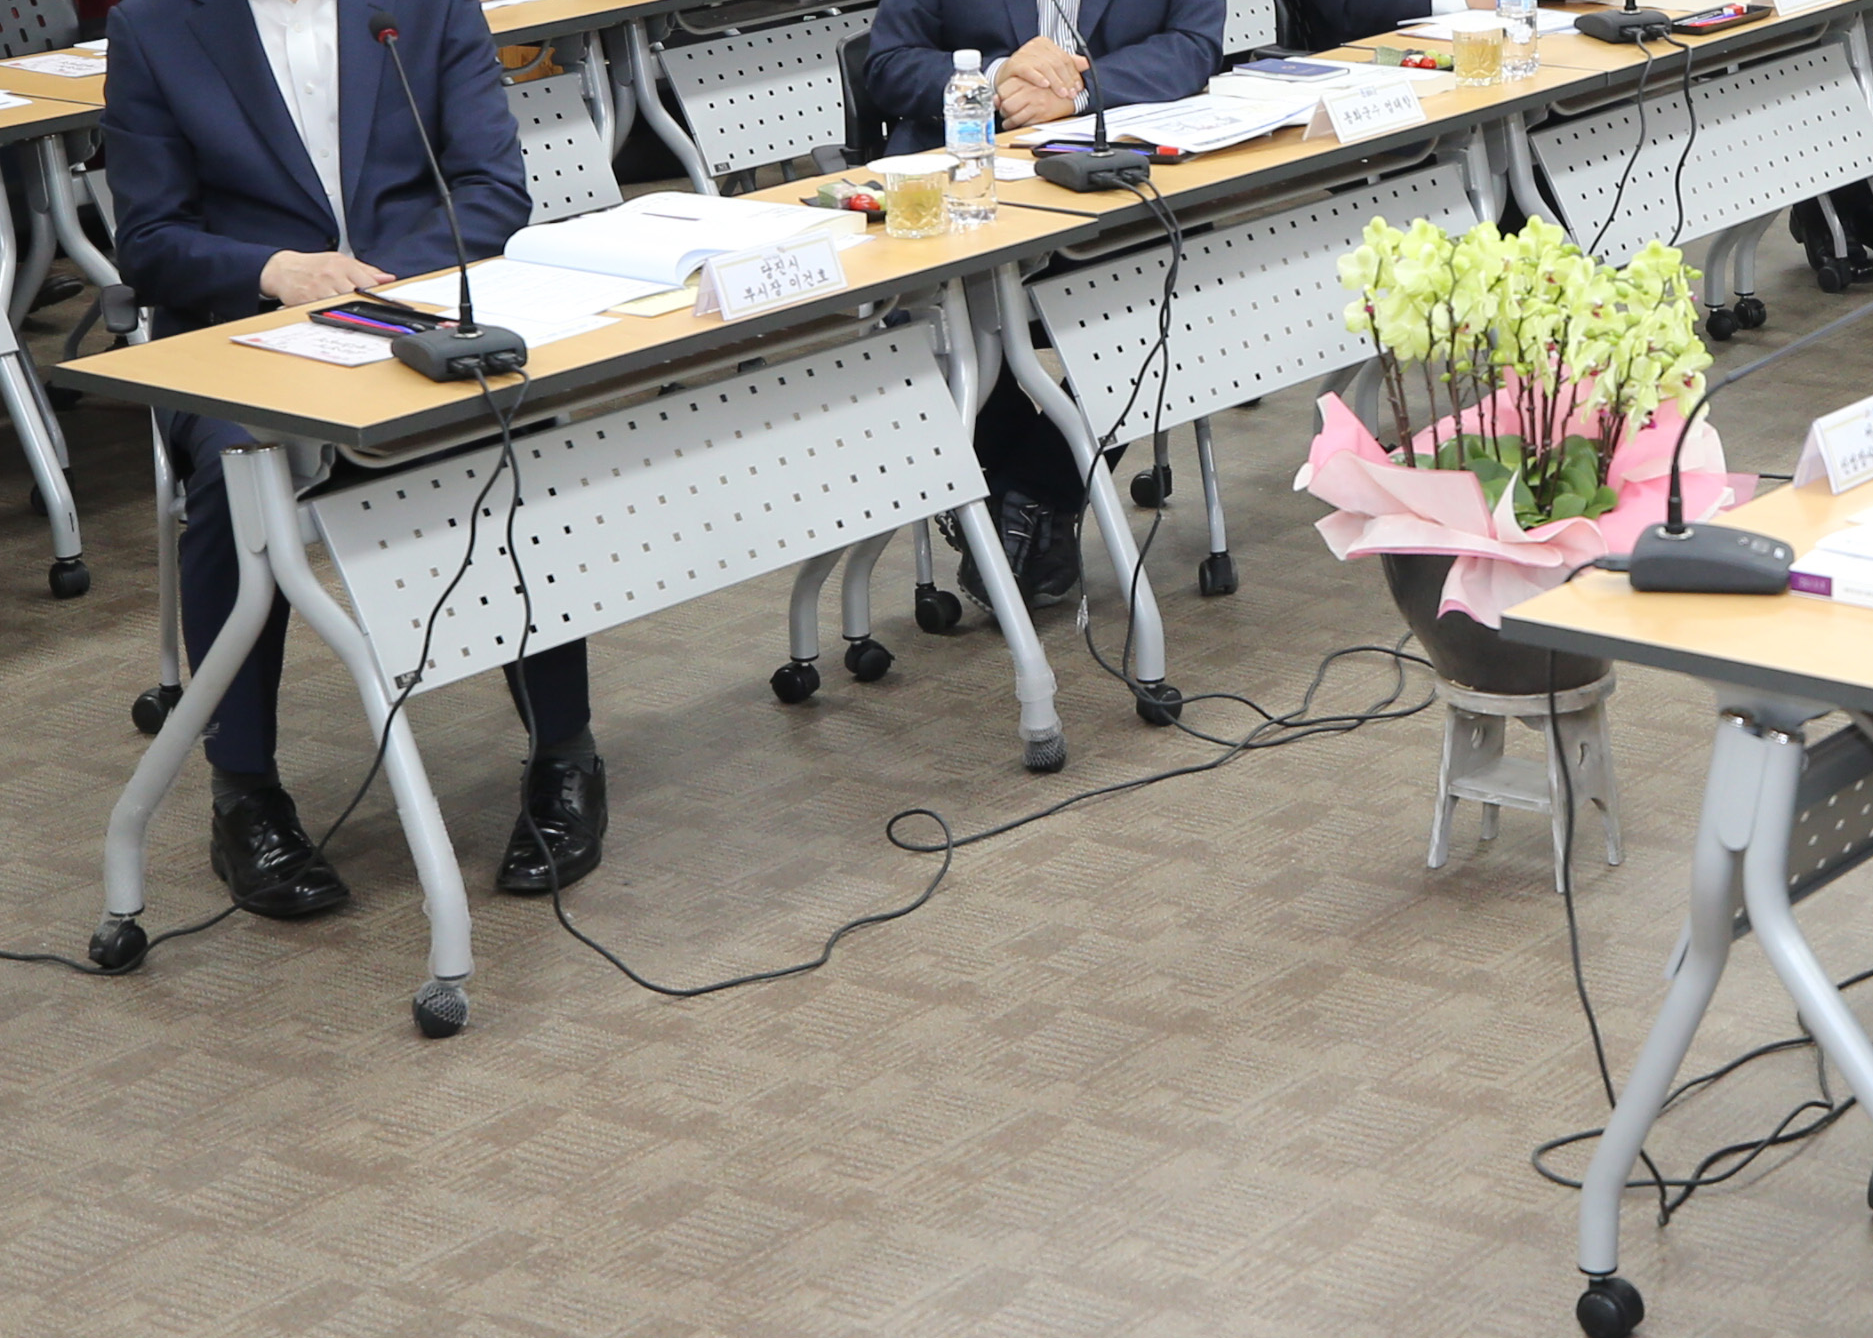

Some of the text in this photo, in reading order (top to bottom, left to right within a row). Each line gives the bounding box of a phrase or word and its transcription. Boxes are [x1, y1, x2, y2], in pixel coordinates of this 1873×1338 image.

[760, 255, 800, 280] 당진시
[743, 268, 830, 303] 부시장 이건호
